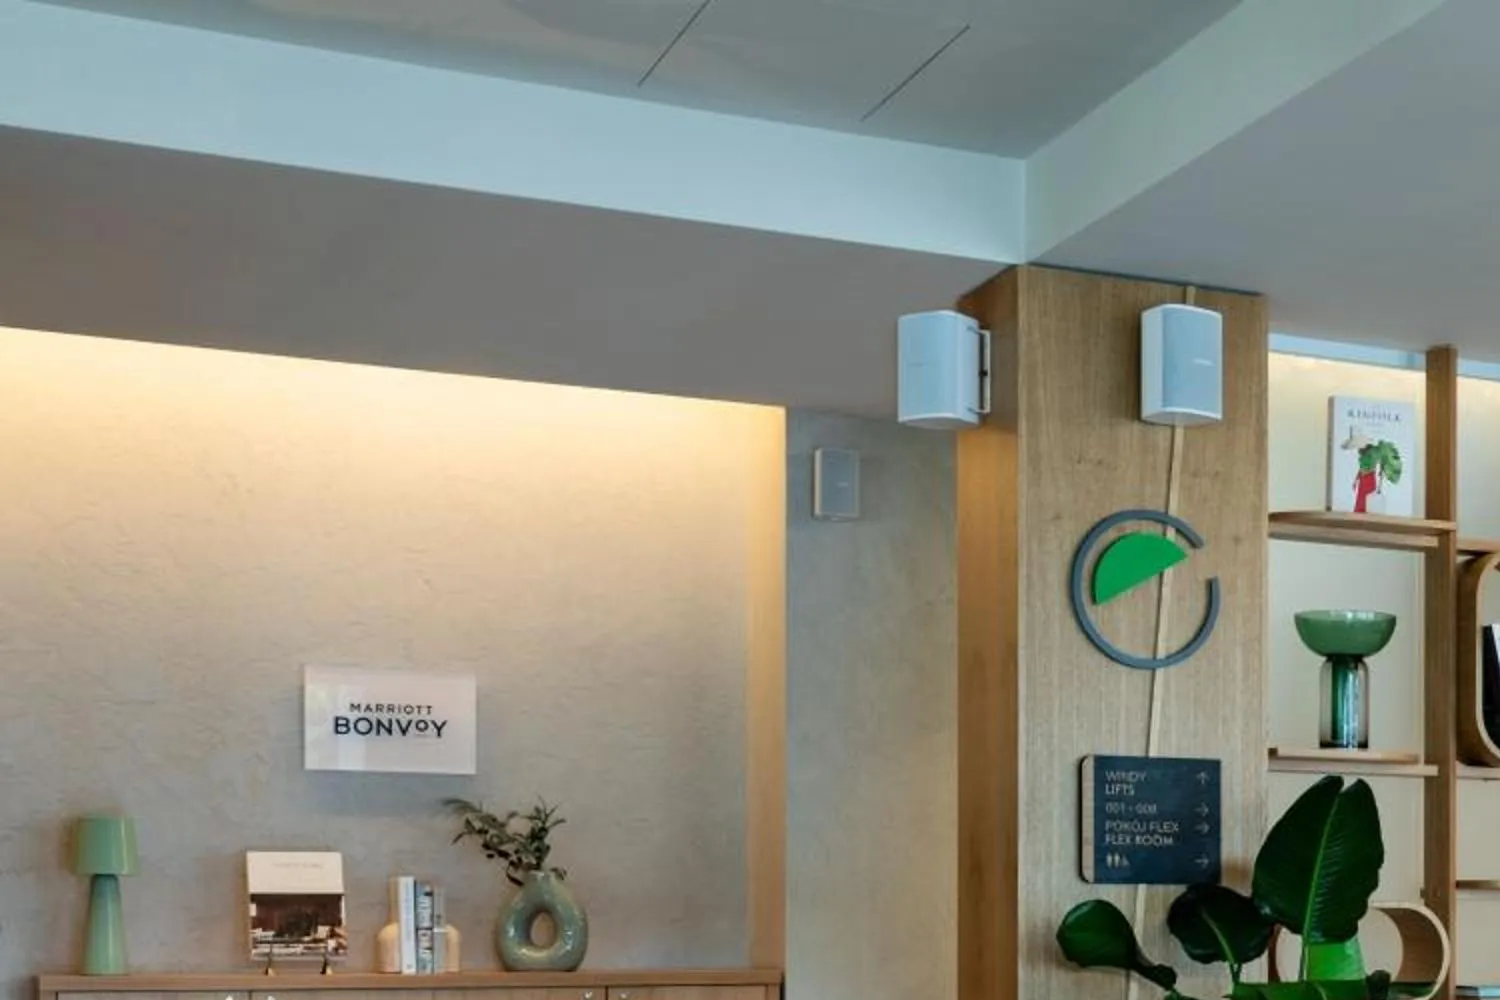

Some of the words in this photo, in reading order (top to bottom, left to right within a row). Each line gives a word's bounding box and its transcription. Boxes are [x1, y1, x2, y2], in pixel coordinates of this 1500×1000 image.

[349, 702, 433, 716] MARRIOTT
[333, 715, 448, 739] BONVOY
[1105, 770, 1147, 783] WINDY
[1105, 783, 1135, 796] LIFTS
[1149, 821, 1180, 833] FLEX
[1105, 833, 1132, 845] FLEX
[1135, 834, 1174, 846] ROOM
